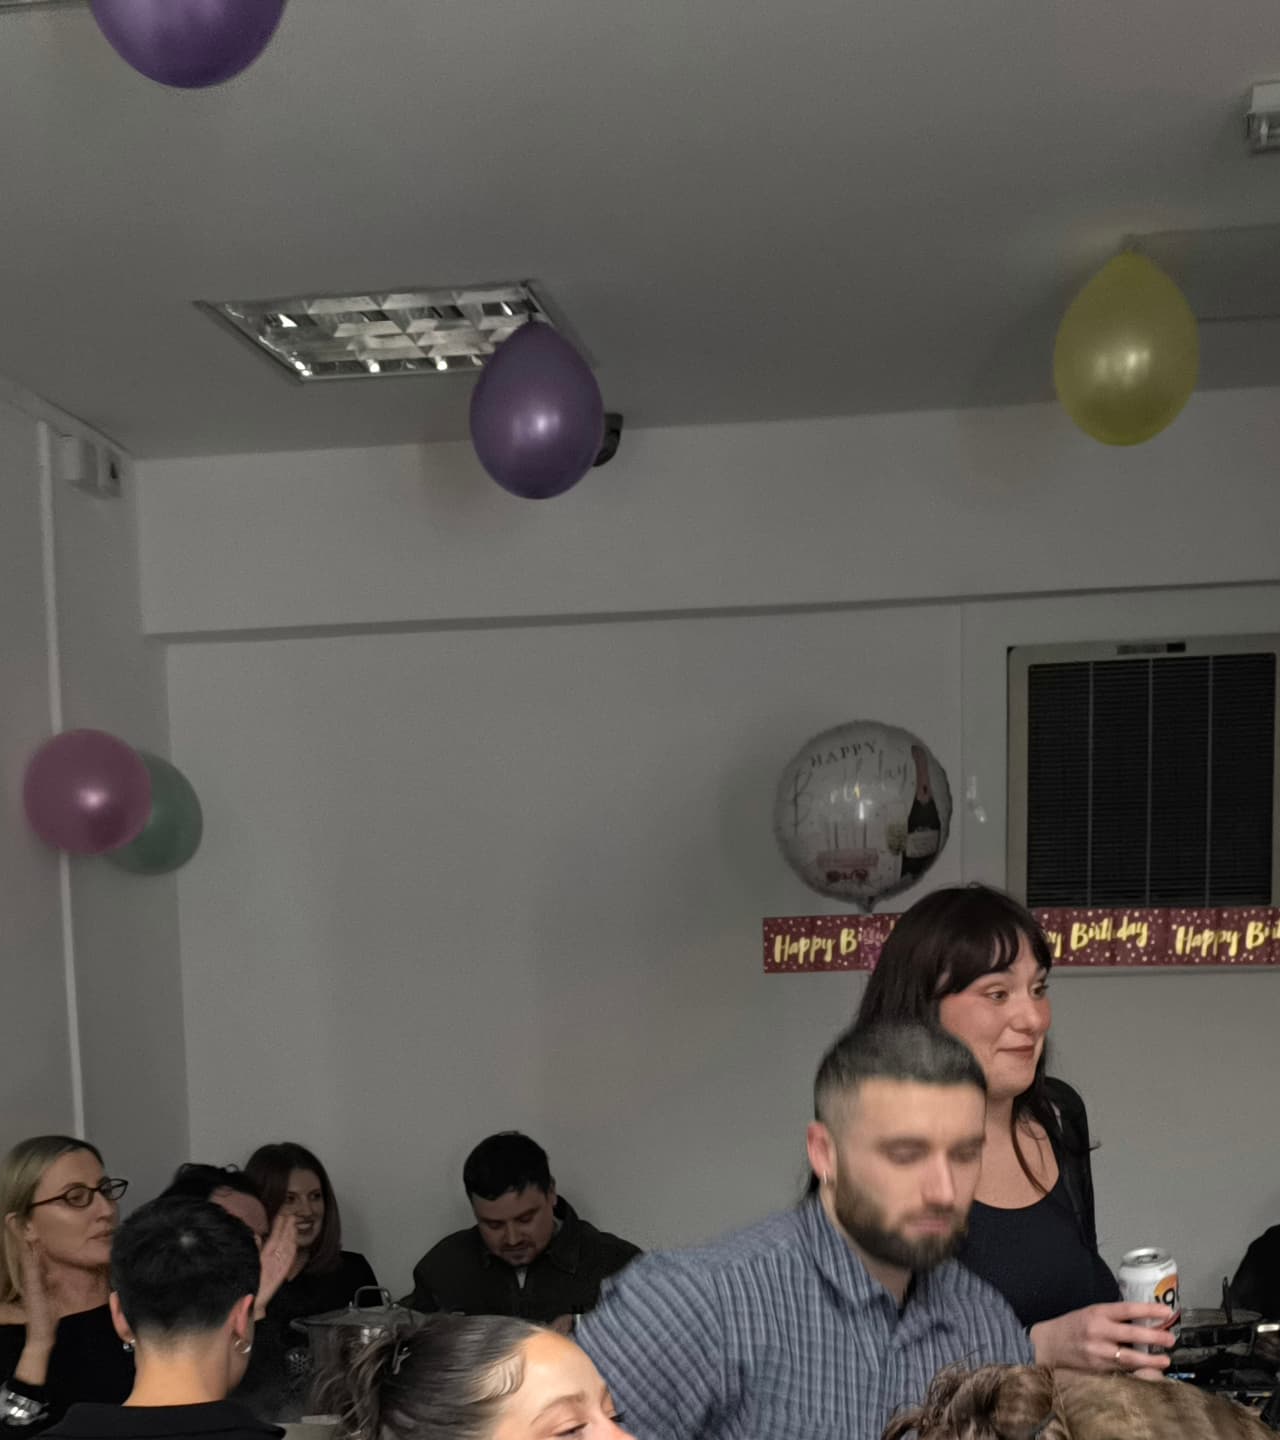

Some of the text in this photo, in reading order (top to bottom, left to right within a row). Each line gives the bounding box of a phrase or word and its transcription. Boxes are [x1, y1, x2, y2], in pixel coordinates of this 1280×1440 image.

[810, 741, 877, 768] HAPPY
[774, 934, 836, 964] Happy
[1175, 926, 1241, 957] Happy
